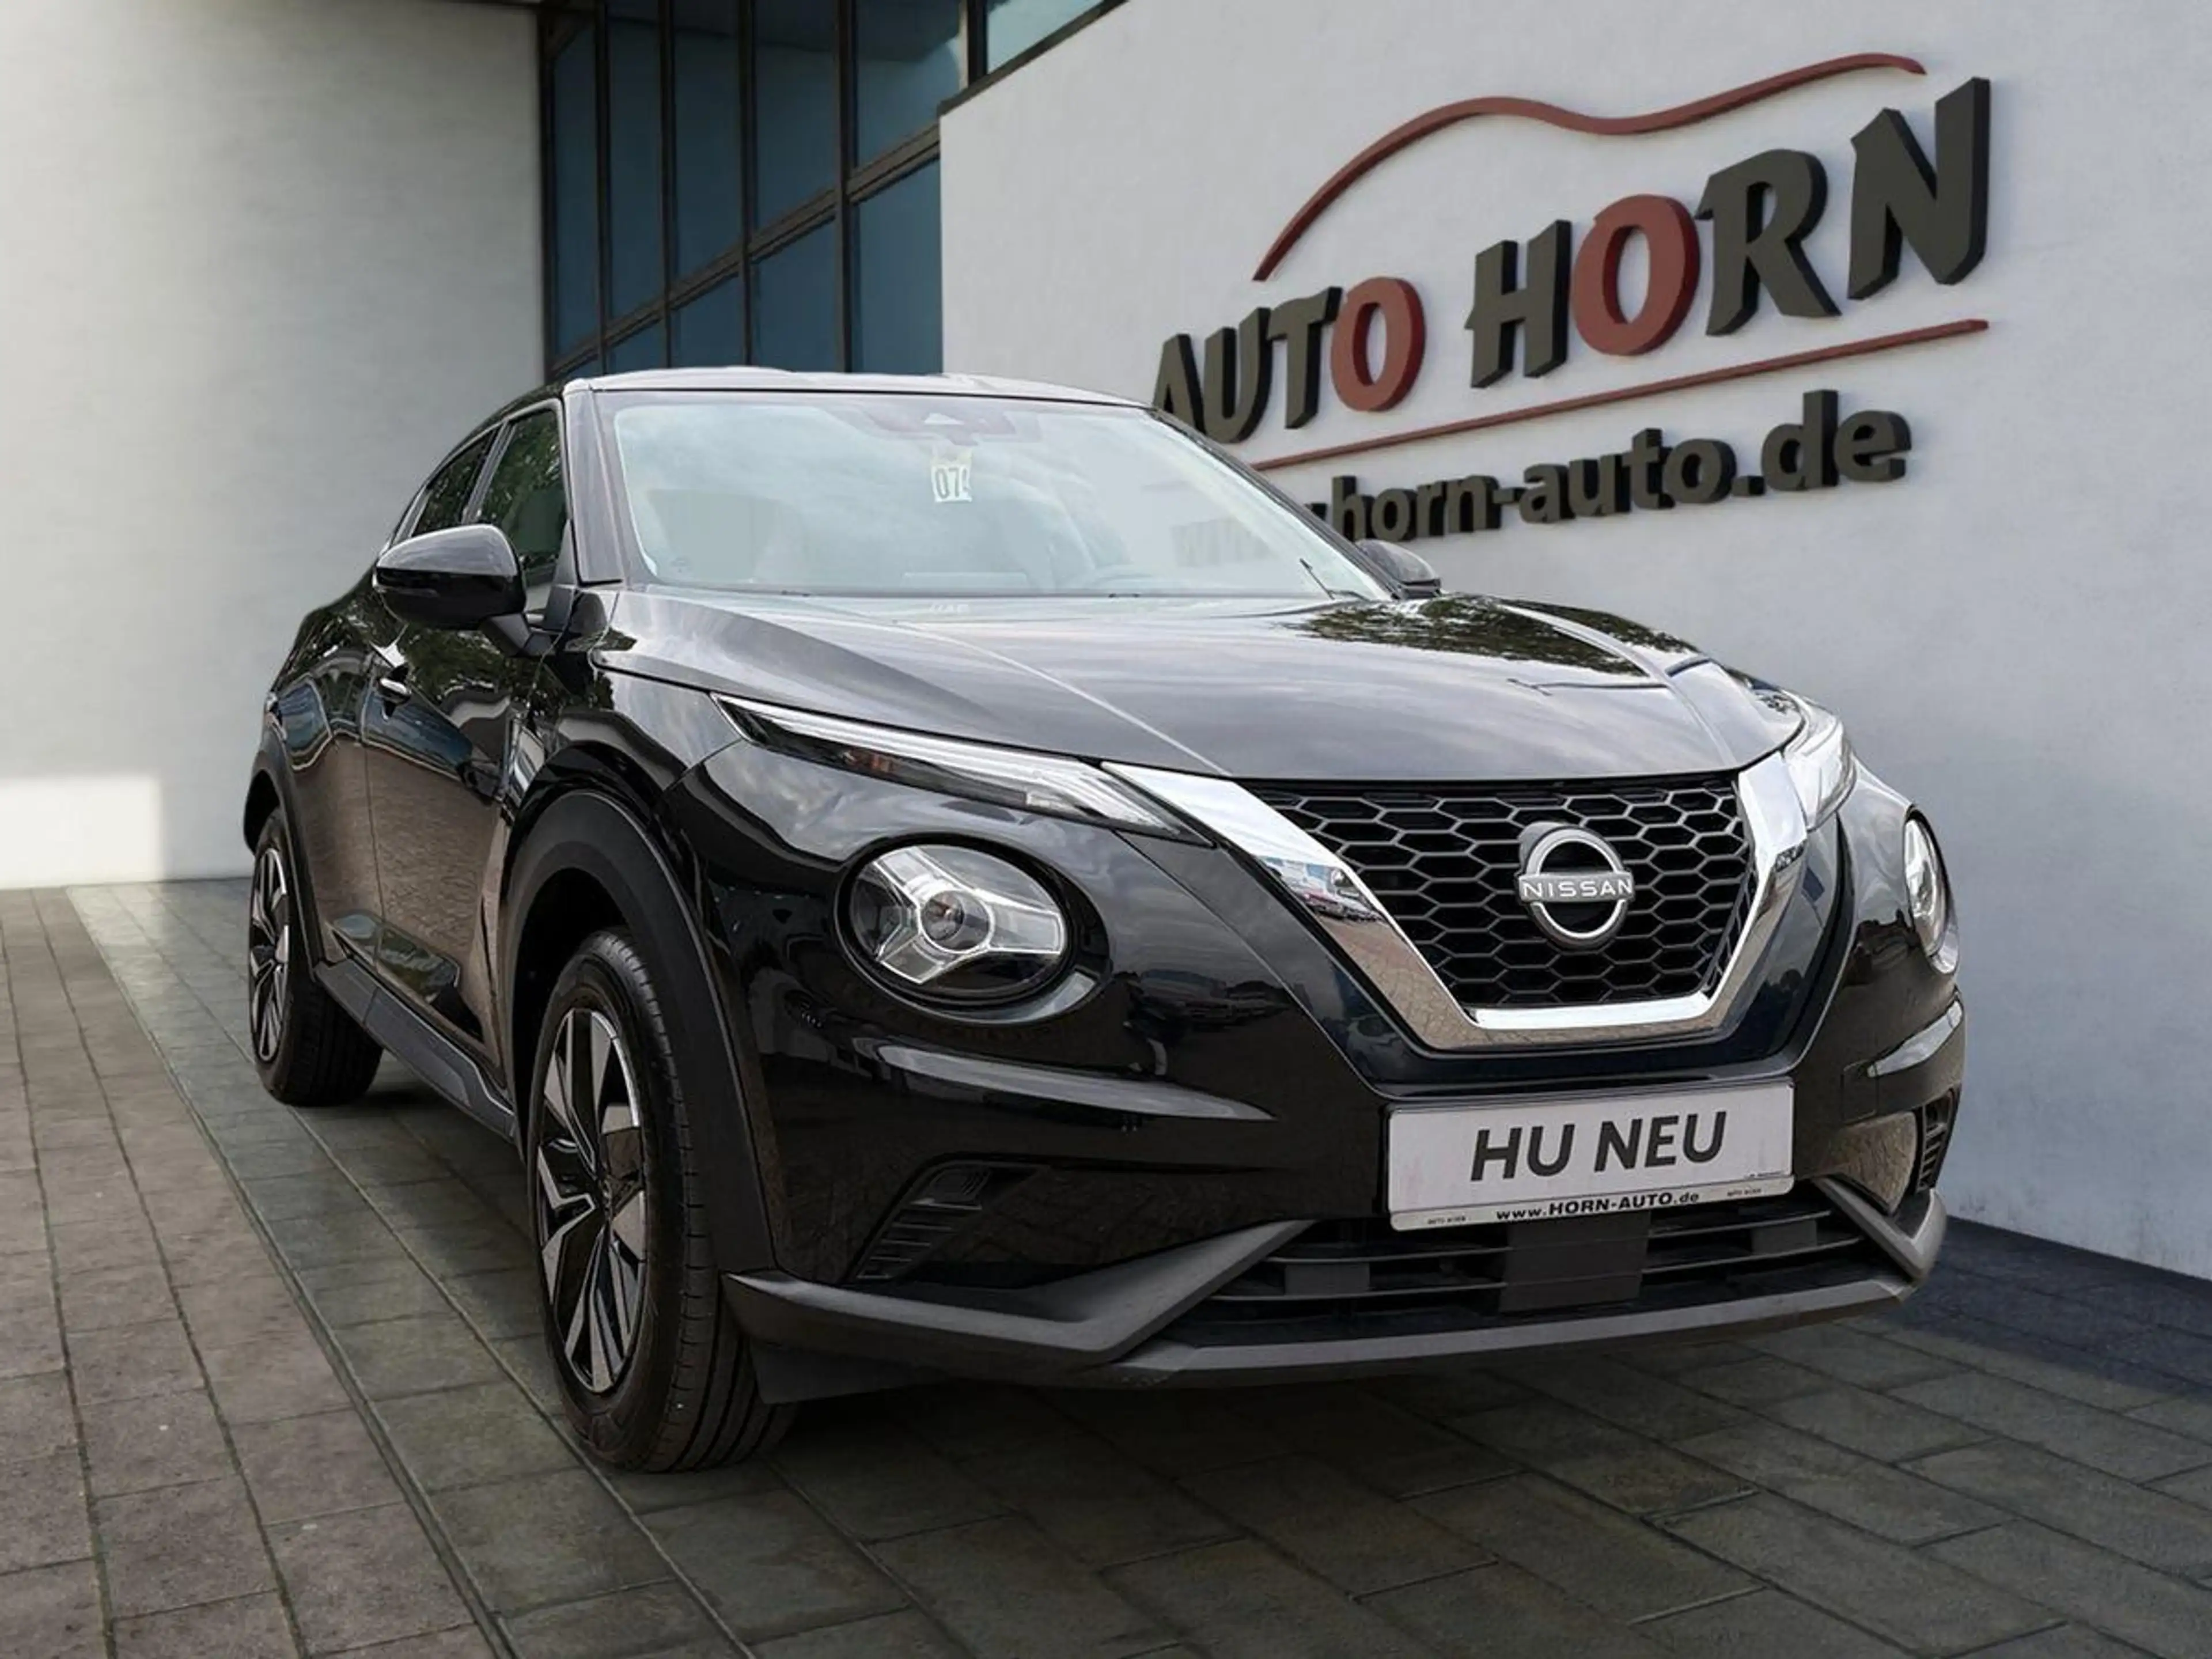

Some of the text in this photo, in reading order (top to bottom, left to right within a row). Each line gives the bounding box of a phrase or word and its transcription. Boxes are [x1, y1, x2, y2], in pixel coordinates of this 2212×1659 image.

[1151, 77, 1991, 444] AUTO HORN
[1305, 388, 1912, 543] horn-auto.de
[1522, 877, 1633, 898] NISSAN
[1470, 1110, 1728, 1182] HU NEU
[1496, 1191, 1699, 1221] www.HORN-AUTO.de
